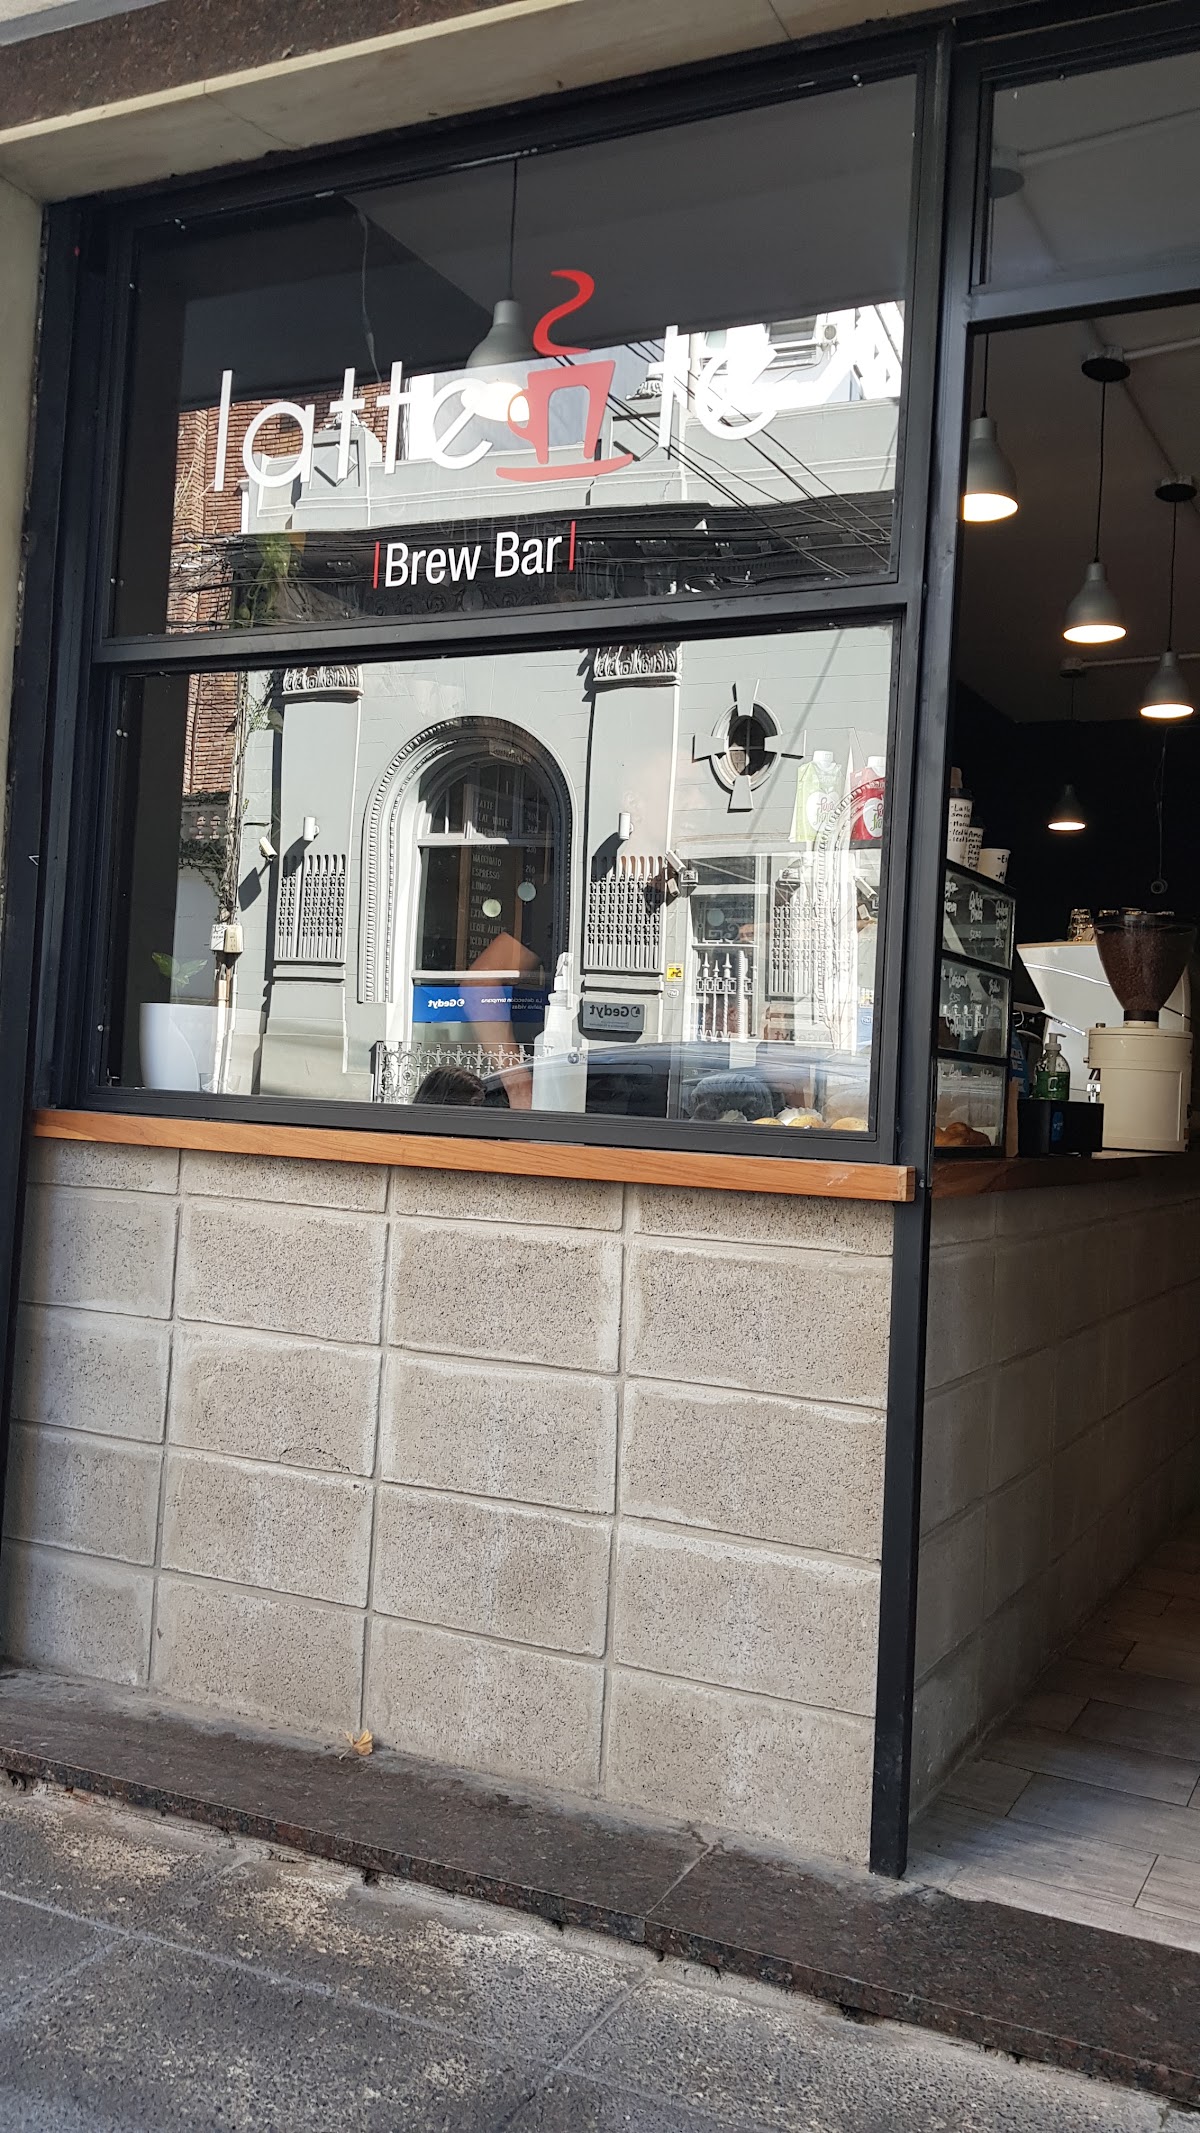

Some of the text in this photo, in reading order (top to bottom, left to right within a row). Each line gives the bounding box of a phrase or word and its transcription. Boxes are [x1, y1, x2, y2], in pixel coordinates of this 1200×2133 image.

[214, 361, 494, 492] latte
[385, 531, 563, 587] Brew Bar
